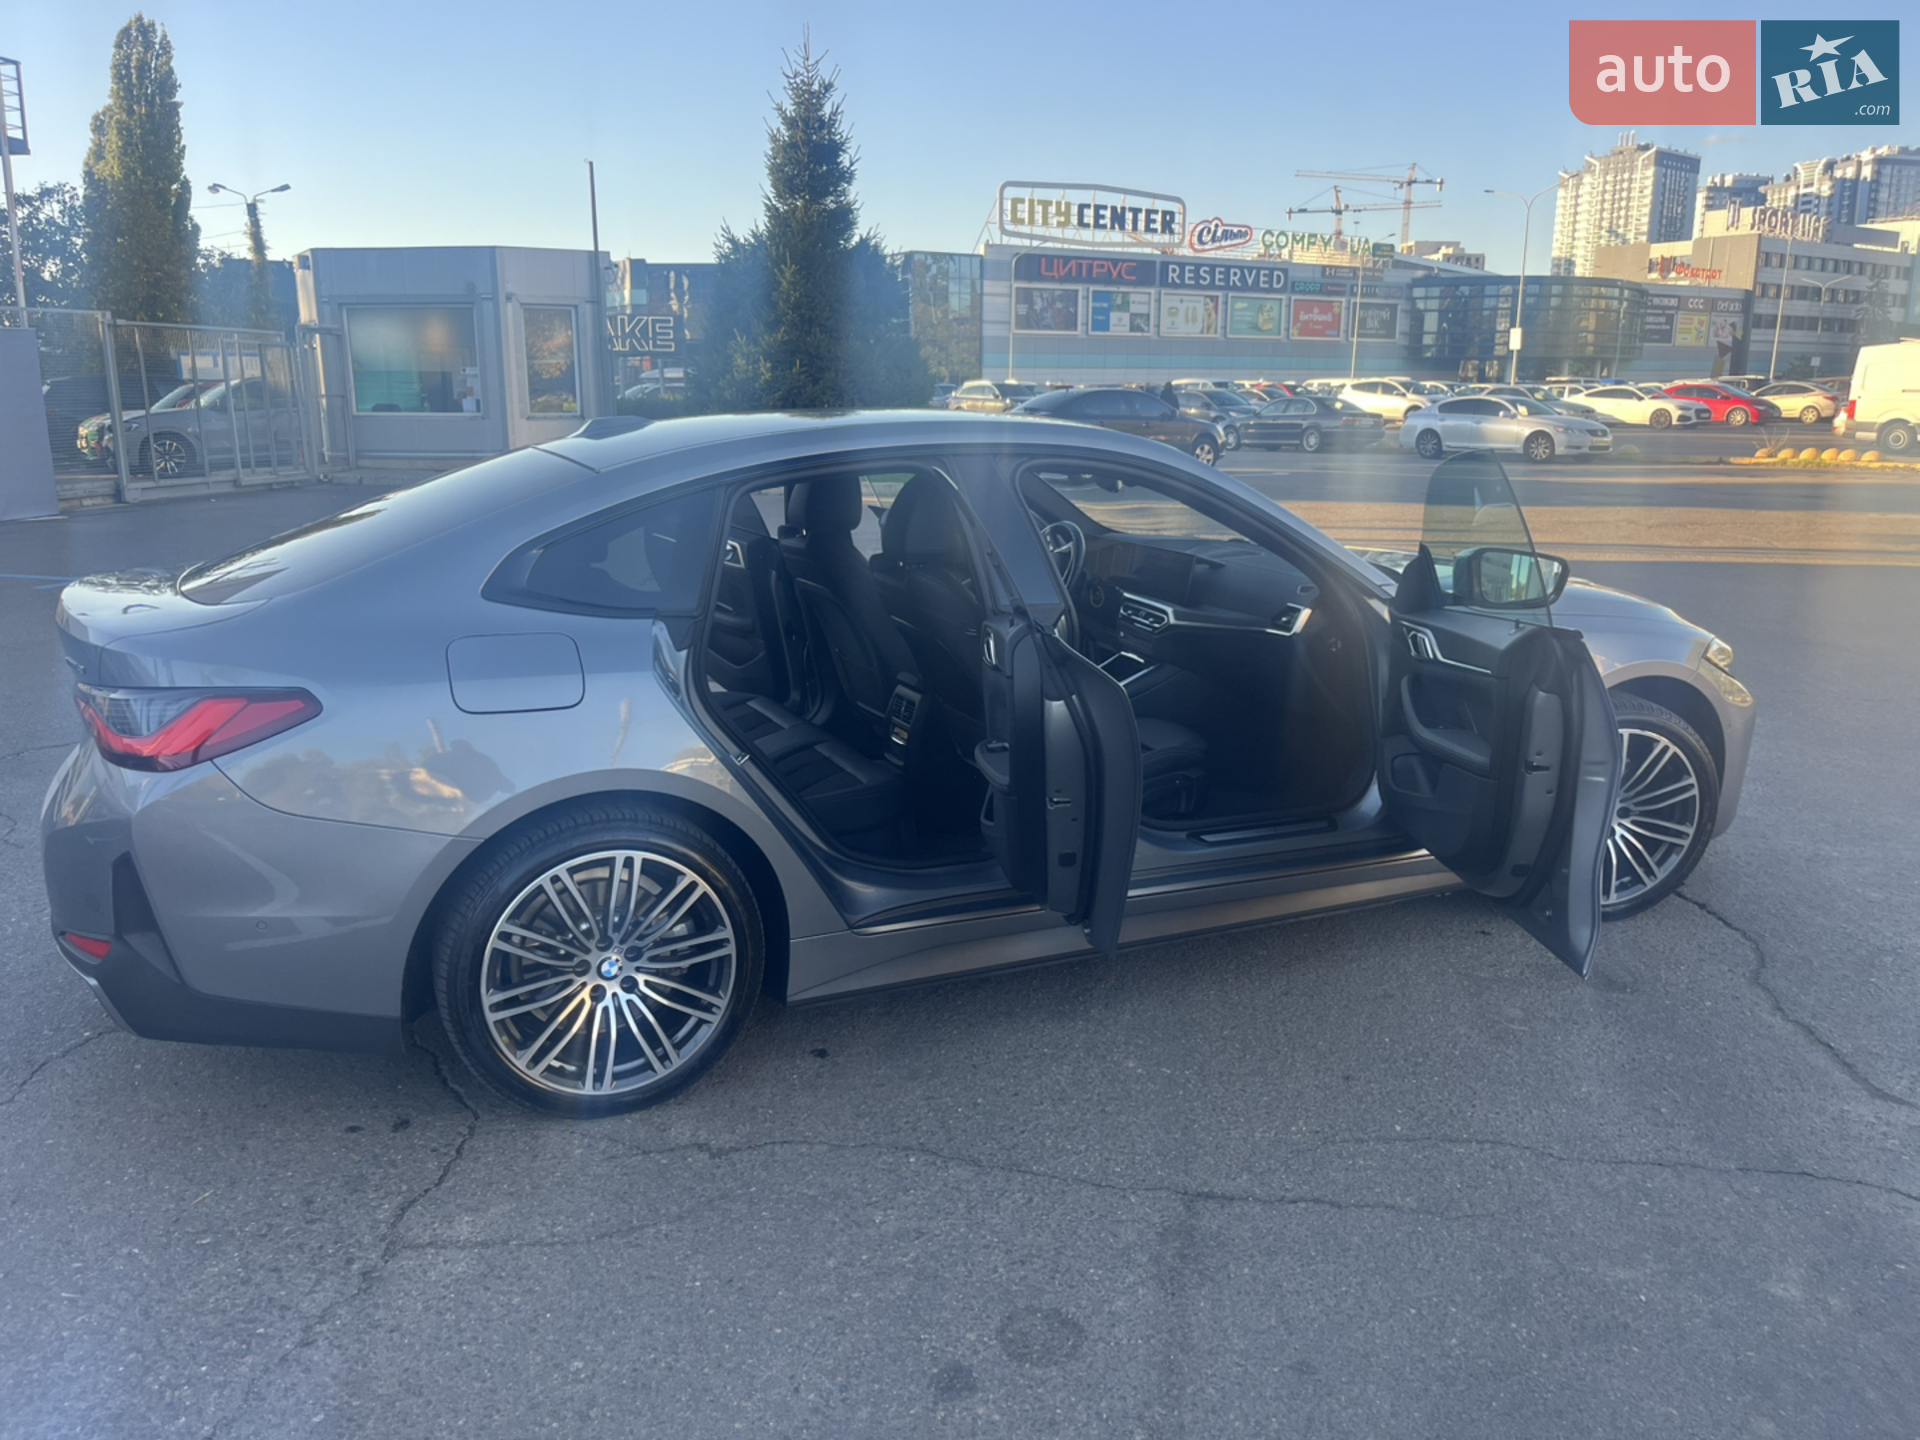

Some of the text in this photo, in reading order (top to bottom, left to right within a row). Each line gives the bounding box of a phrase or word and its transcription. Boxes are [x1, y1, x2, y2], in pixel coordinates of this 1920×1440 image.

[1010, 197, 1176, 235] CITY CENTER
[1196, 223, 1249, 246] Сільпо
[1040, 257, 1137, 280] ЦИТРУС
[1168, 264, 1285, 289] RESERVED
[1294, 282, 1321, 293] CROPP
[1687, 298, 1704, 309] CCC
